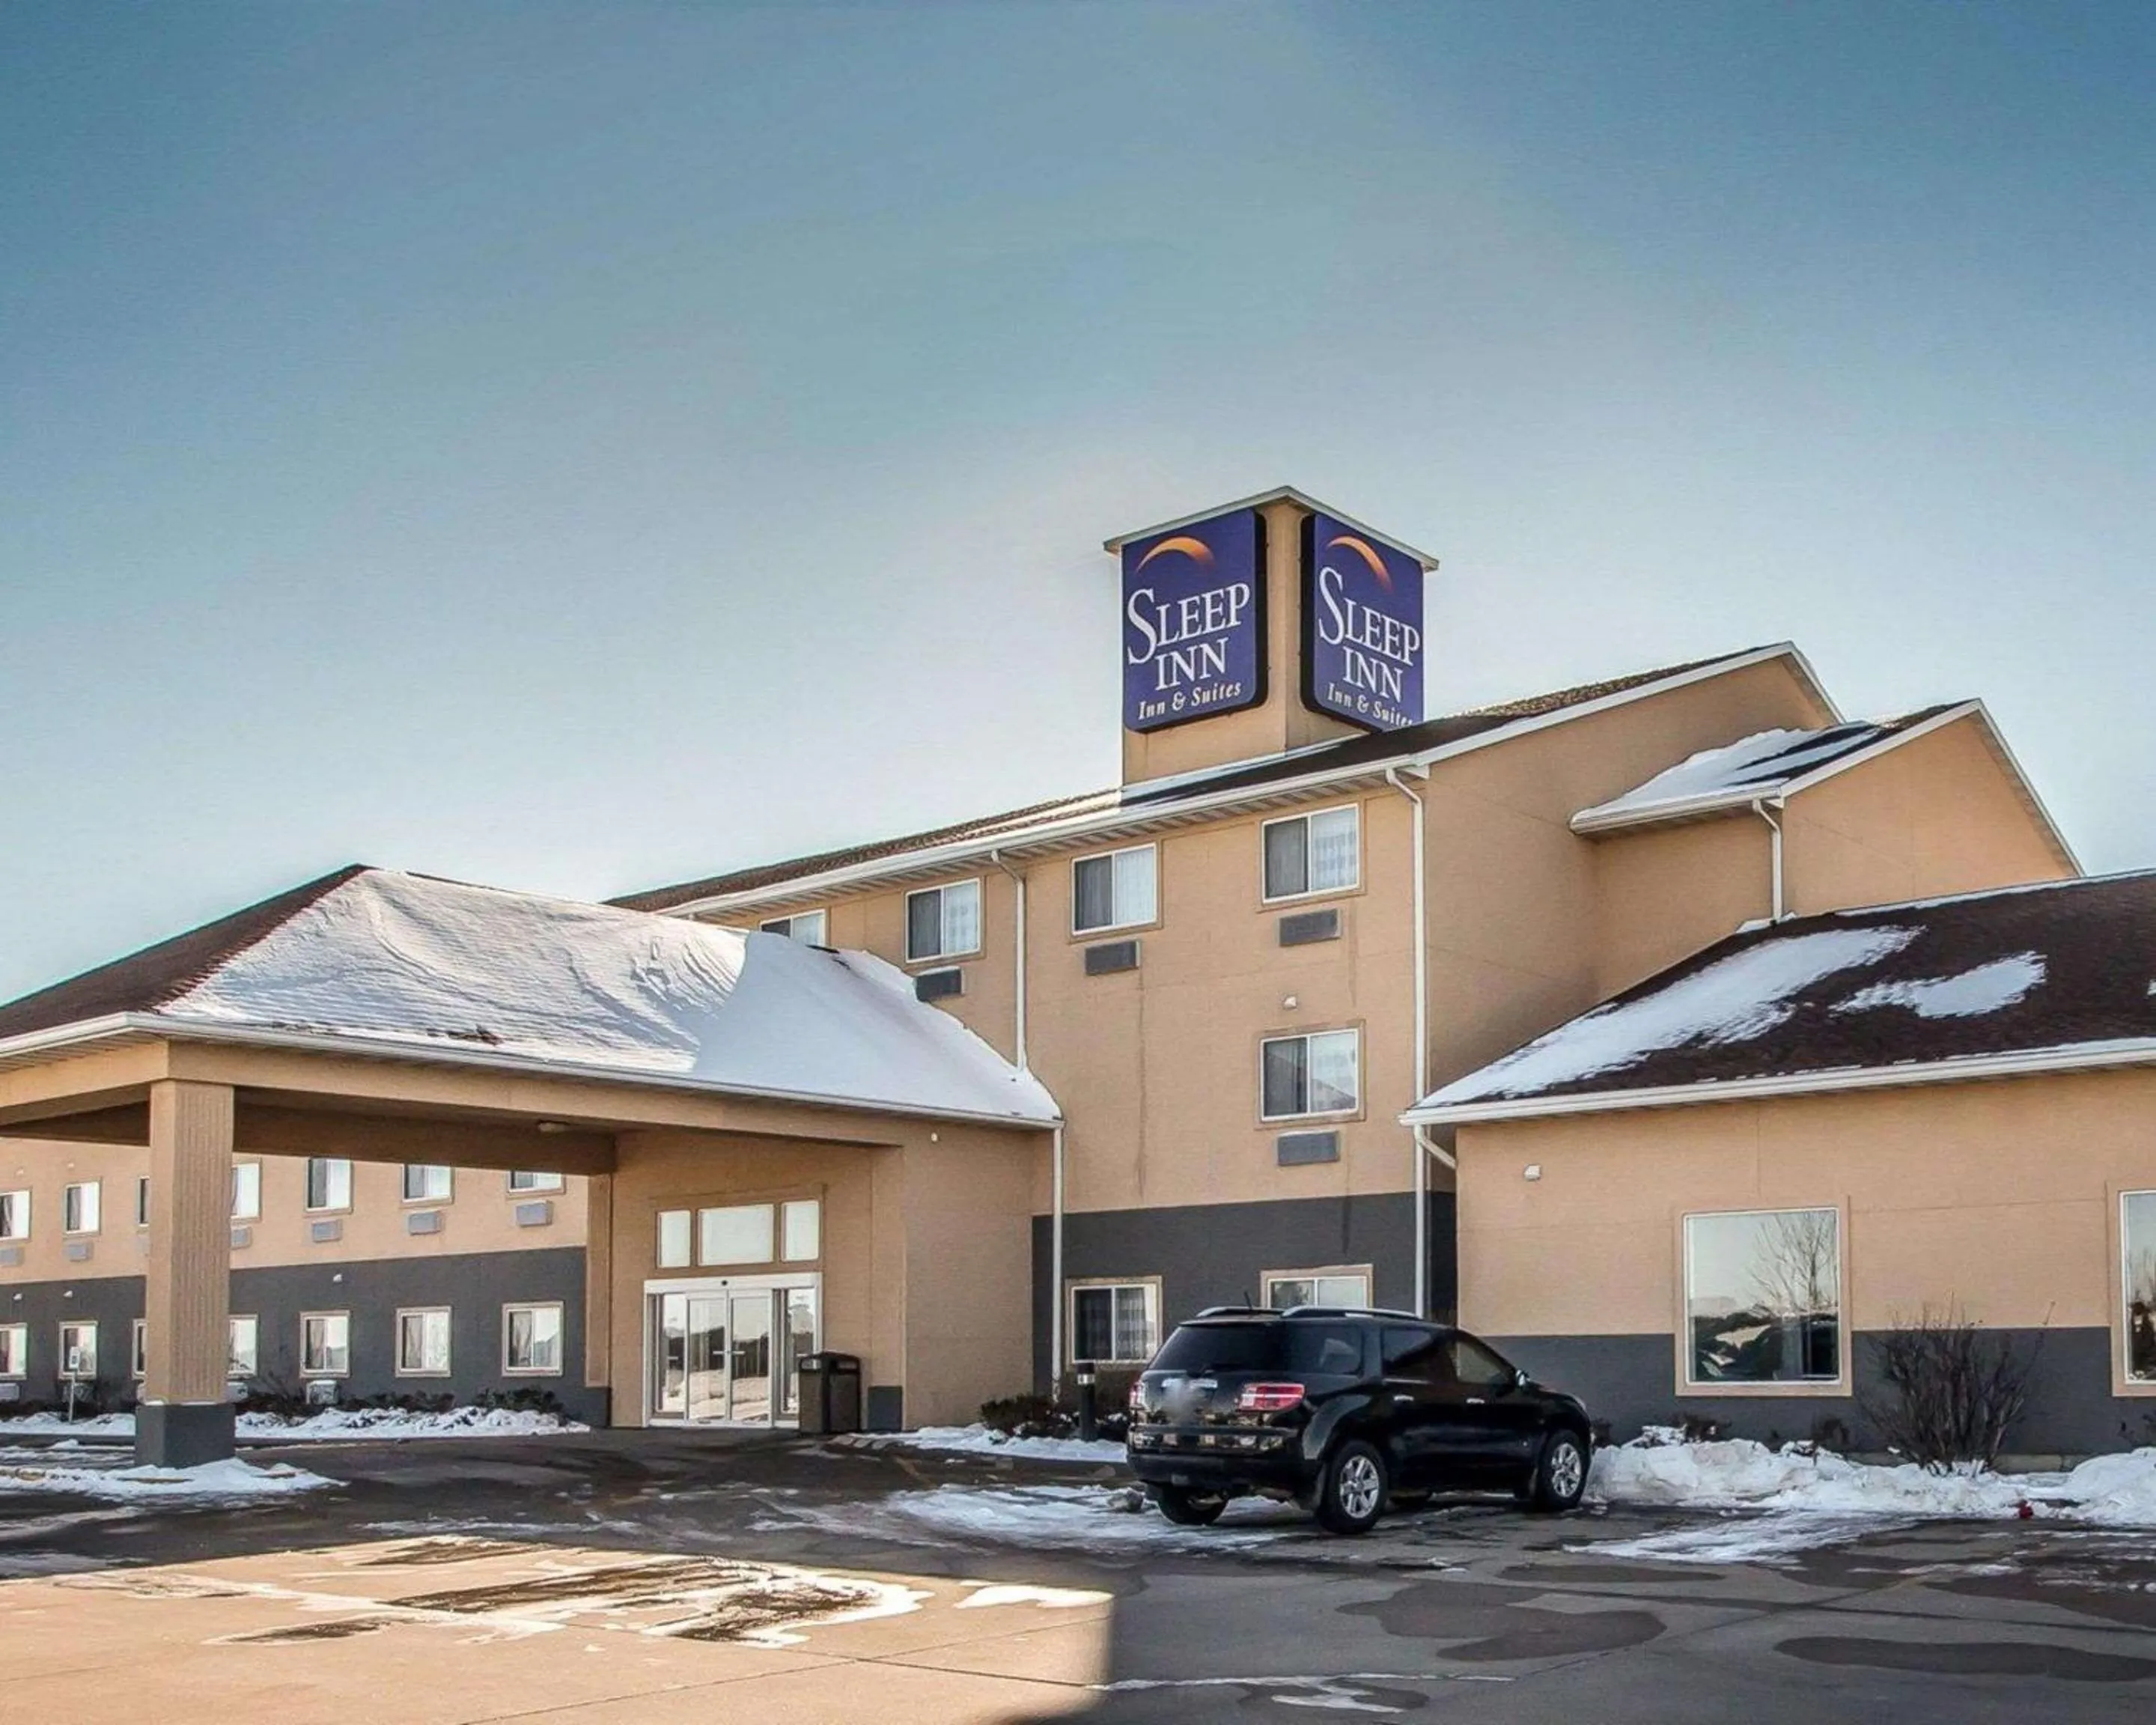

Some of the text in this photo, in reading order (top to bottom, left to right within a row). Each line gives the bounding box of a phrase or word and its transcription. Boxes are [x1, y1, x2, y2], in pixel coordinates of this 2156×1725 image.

[1127, 583, 1250, 664] SLEEP
[1319, 567, 1419, 666] SLEEP
[1155, 638, 1228, 690] INN
[1342, 647, 1403, 702] INN
[1138, 683, 1241, 719] Inn & Suites
[1327, 684, 1352, 706] Inn
[1356, 695, 1369, 714] &
